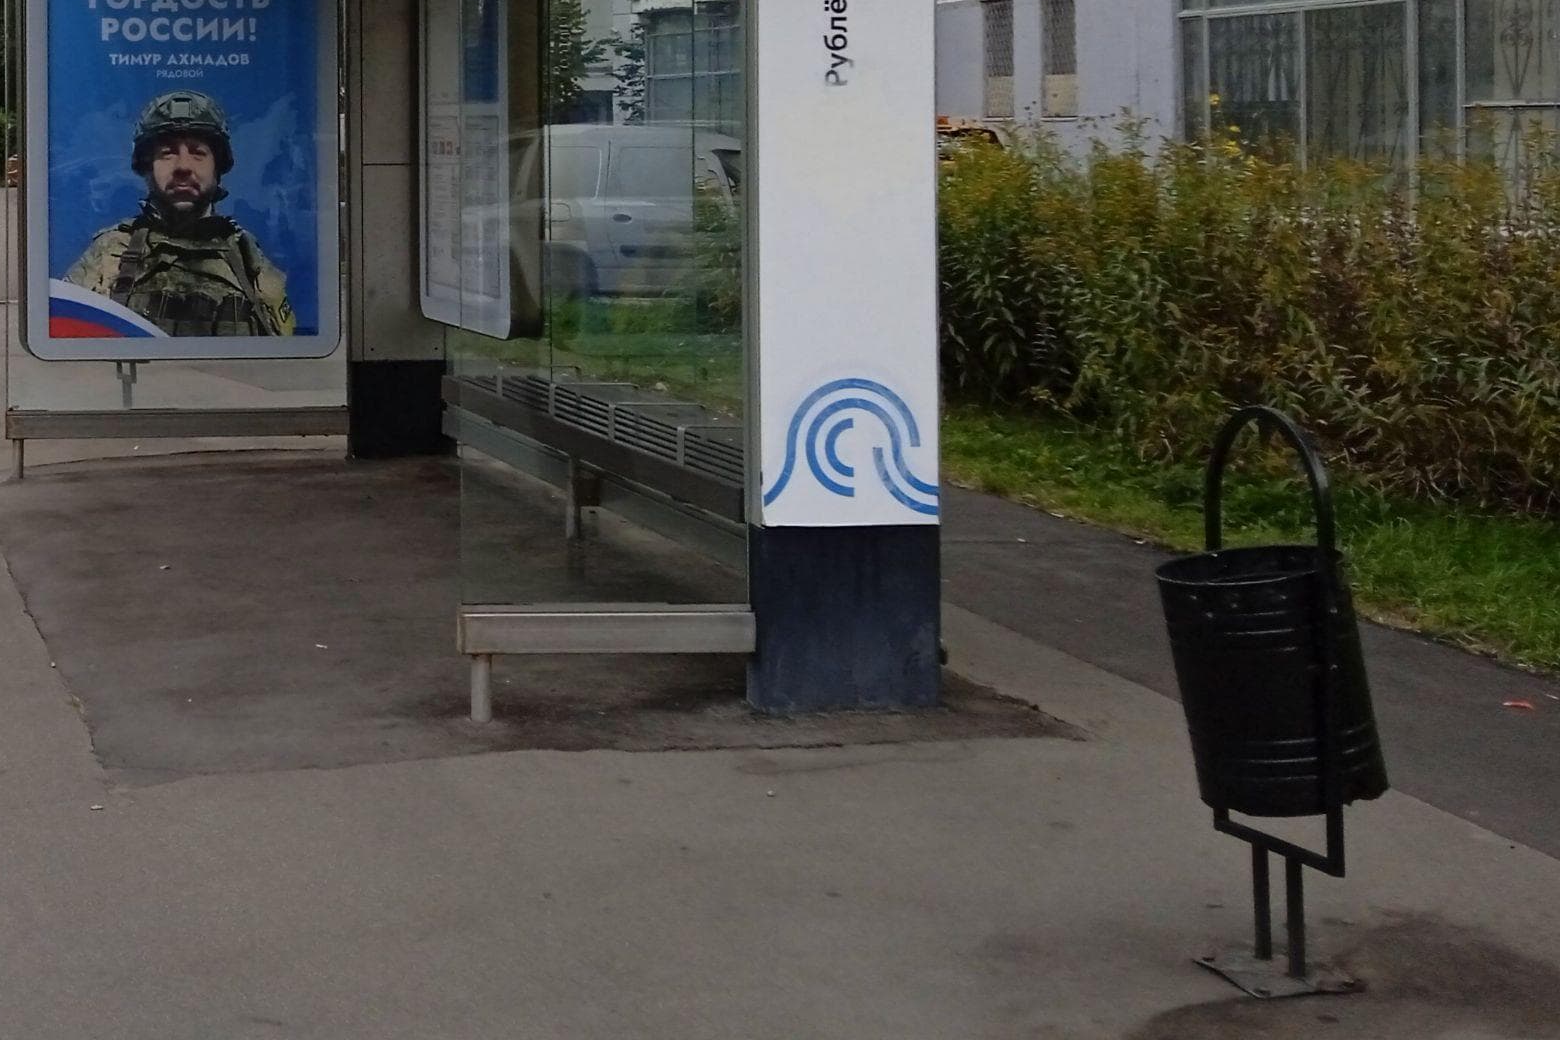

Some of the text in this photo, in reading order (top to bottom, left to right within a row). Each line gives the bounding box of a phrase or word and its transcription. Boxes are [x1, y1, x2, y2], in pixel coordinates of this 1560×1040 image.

[101, 17, 257, 42] РОССИИ!
[109, 53, 251, 66] ТИМУР АХМАДОВ
[156, 69, 204, 79] РЯДОВОЙ
